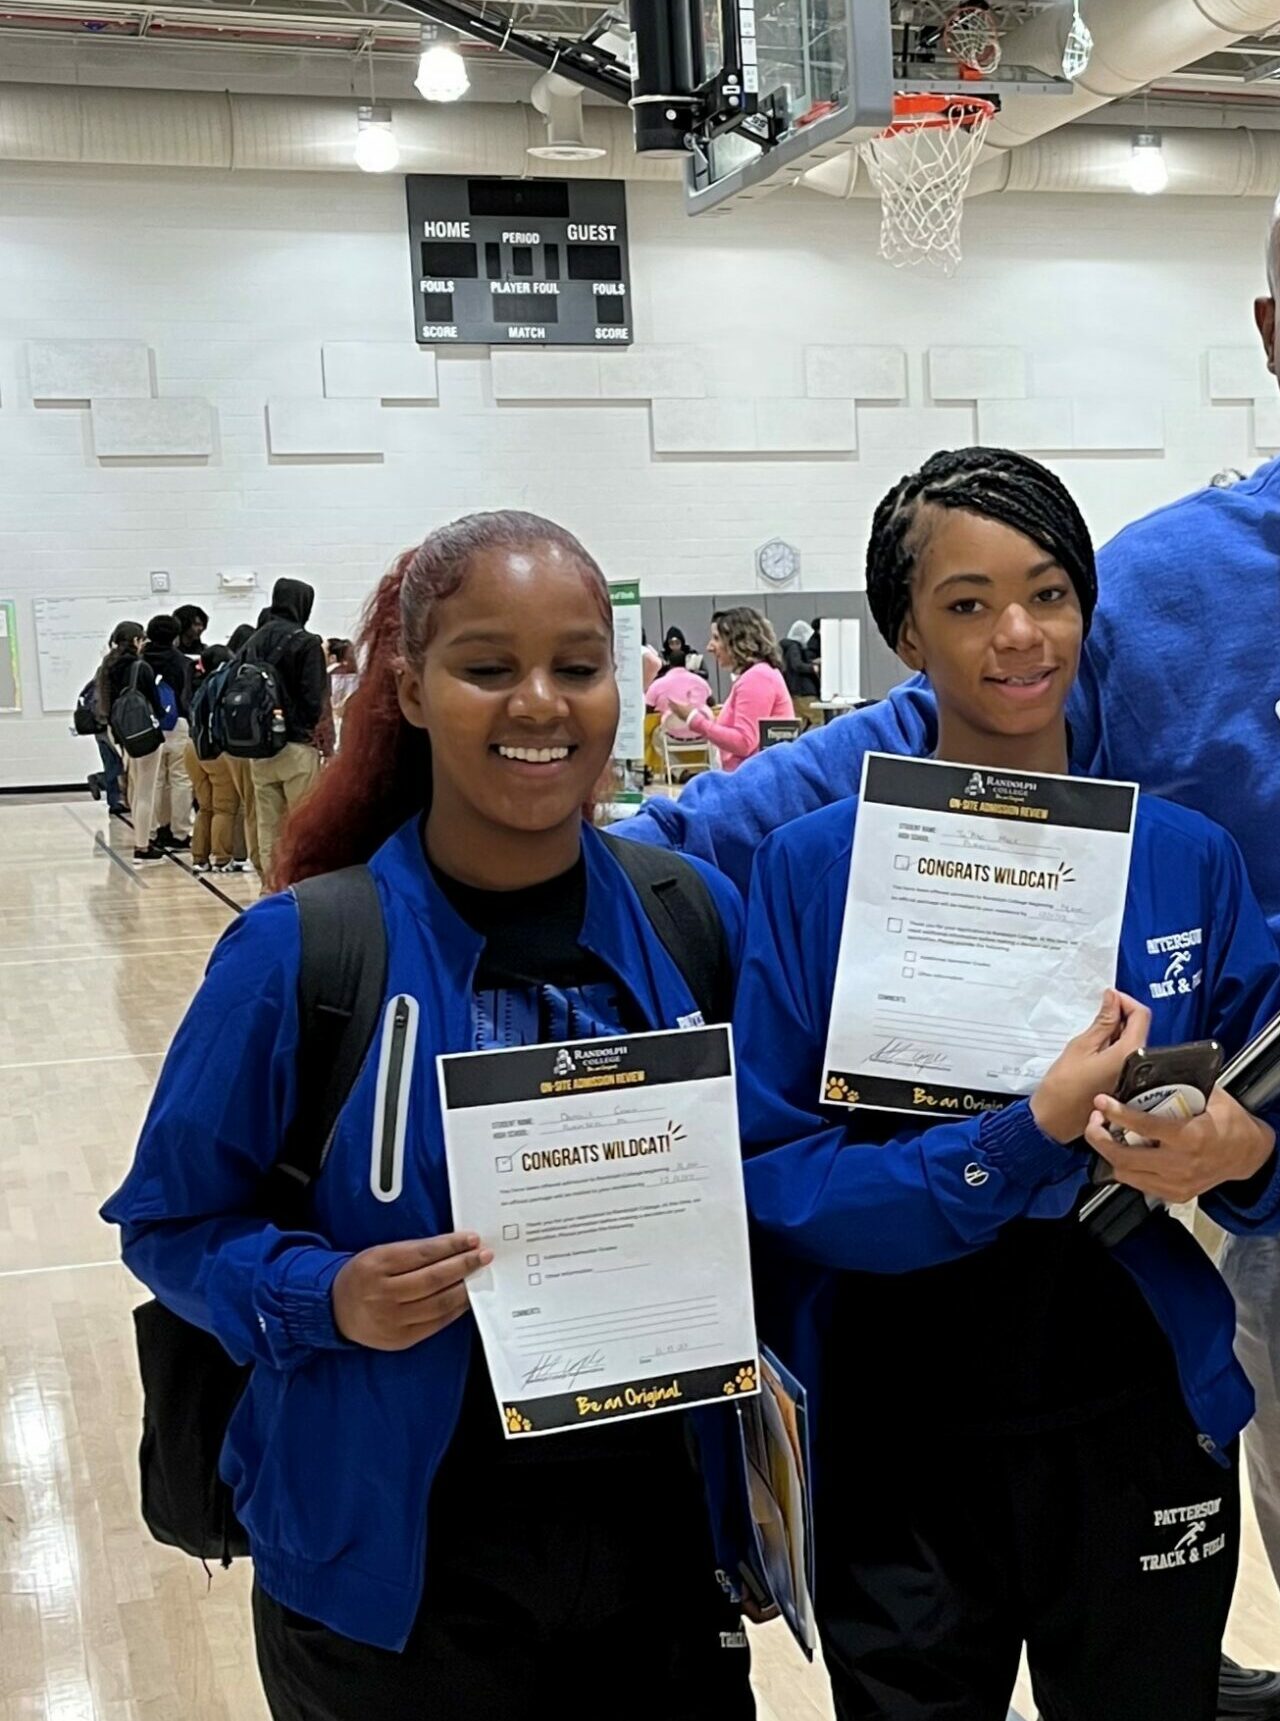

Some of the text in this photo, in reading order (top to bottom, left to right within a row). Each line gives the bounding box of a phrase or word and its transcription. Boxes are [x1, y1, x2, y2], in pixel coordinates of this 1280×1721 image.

[424, 221, 470, 238] HOME
[567, 224, 617, 241] GUEST
[502, 232, 540, 244] PERIOD
[420, 280, 455, 293] FOULS
[490, 281, 560, 294] PLAYER FOUL
[593, 283, 625, 295] FOULS
[422, 326, 458, 338] SCORE
[508, 327, 545, 339] MATCH
[595, 327, 629, 339] SCORE
[986, 775, 1037, 791] RANDOLPH
[917, 857, 1060, 891] CONGRATS WILDCAT!
[1178, 978, 1192, 994] &
[574, 1046, 628, 1060] RANDOLPH
[582, 1056, 621, 1067] COLLEGE
[913, 1087, 1004, 1111] Be an Origin
[522, 1134, 671, 1171] CONGRATS WILDCAT!
[576, 1379, 683, 1416] Be an Original
[1153, 1497, 1222, 1526] PATTERSON
[1139, 1549, 1186, 1571] TRACK
[1188, 1547, 1200, 1563] &
